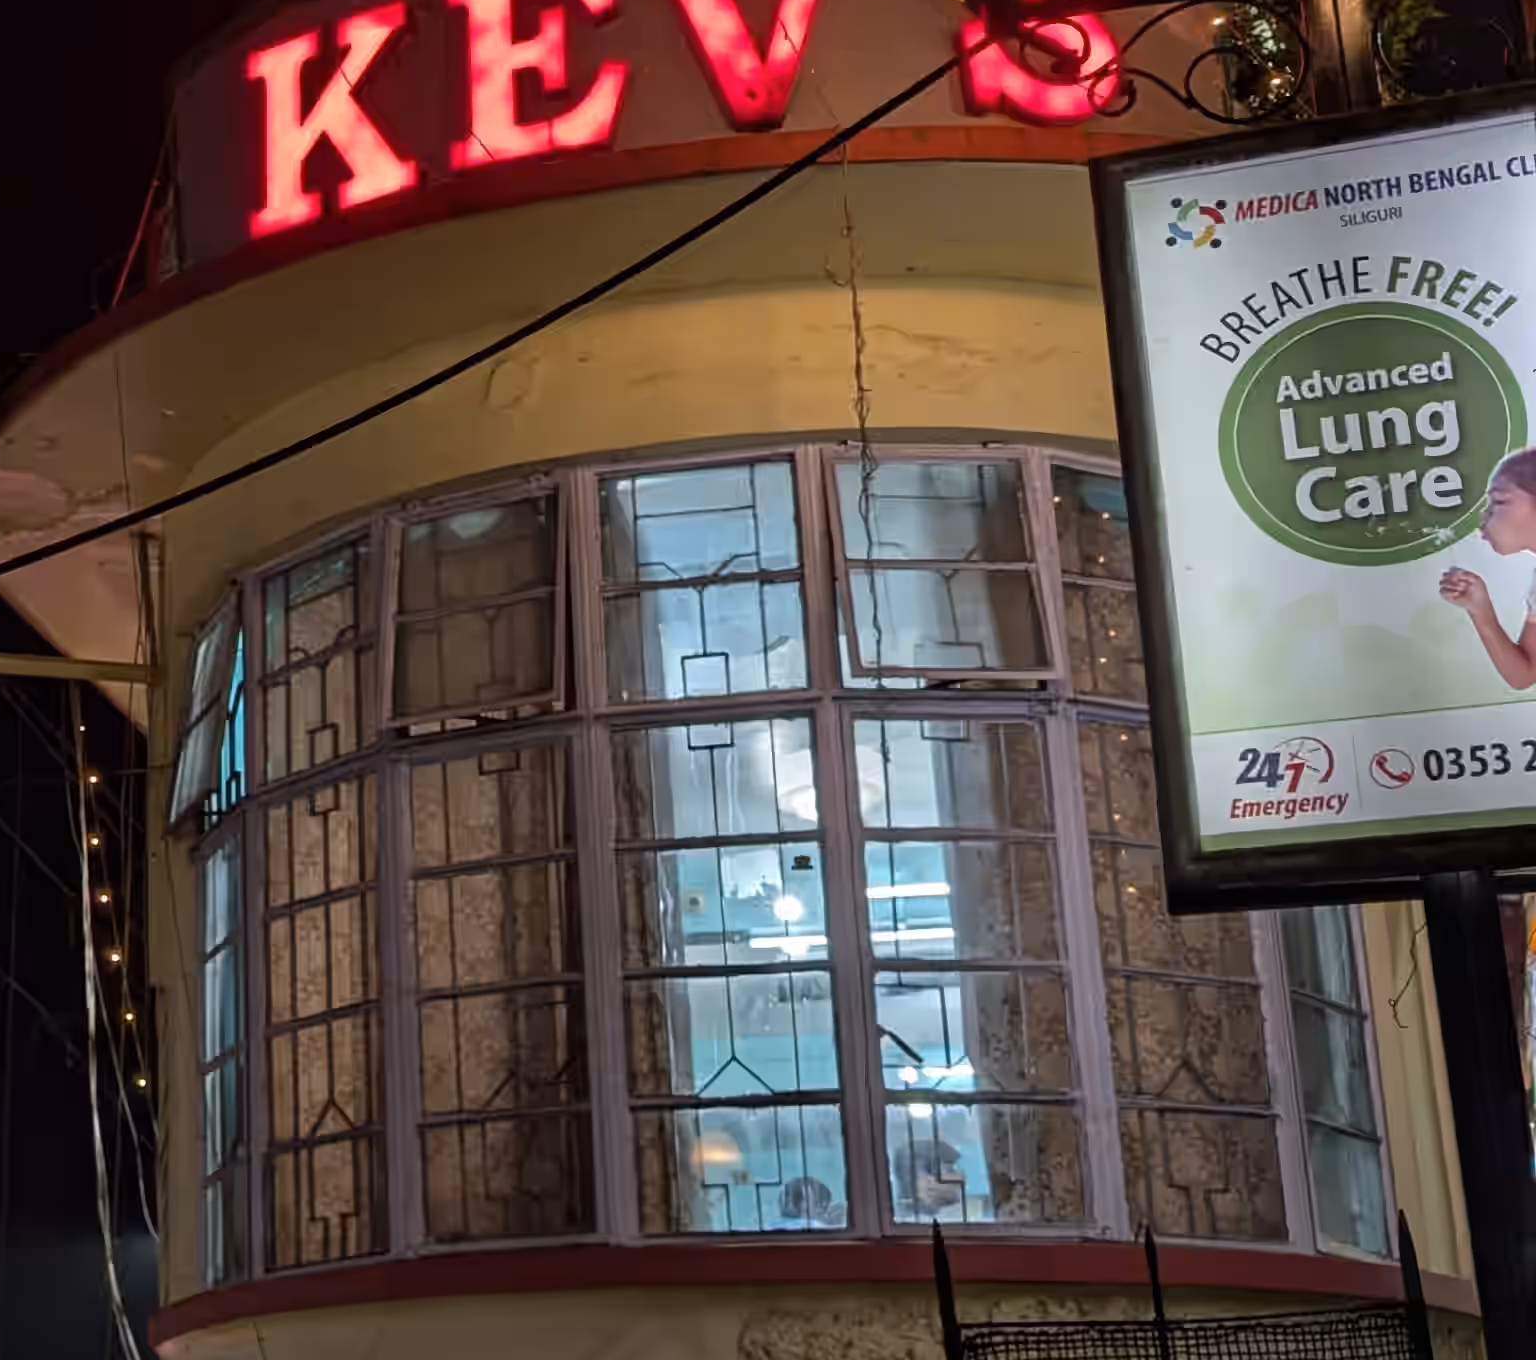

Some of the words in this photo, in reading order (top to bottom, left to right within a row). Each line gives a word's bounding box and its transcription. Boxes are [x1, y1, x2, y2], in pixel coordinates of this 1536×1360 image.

[1235, 189, 1319, 222] MEDICA
[1324, 176, 1403, 208] NORTH
[1408, 160, 1502, 194] BENGAL
[1340, 207, 1403, 228] SILIGURI
[1200, 255, 1370, 363] BREATHE
[1386, 255, 1518, 328] FREE!
[1276, 351, 1454, 403] Advanced
[1279, 399, 1461, 460] Lung
[1295, 466, 1464, 523] Care
[1423, 743, 1512, 781] 0353
[1230, 792, 1349, 820] Emergency
